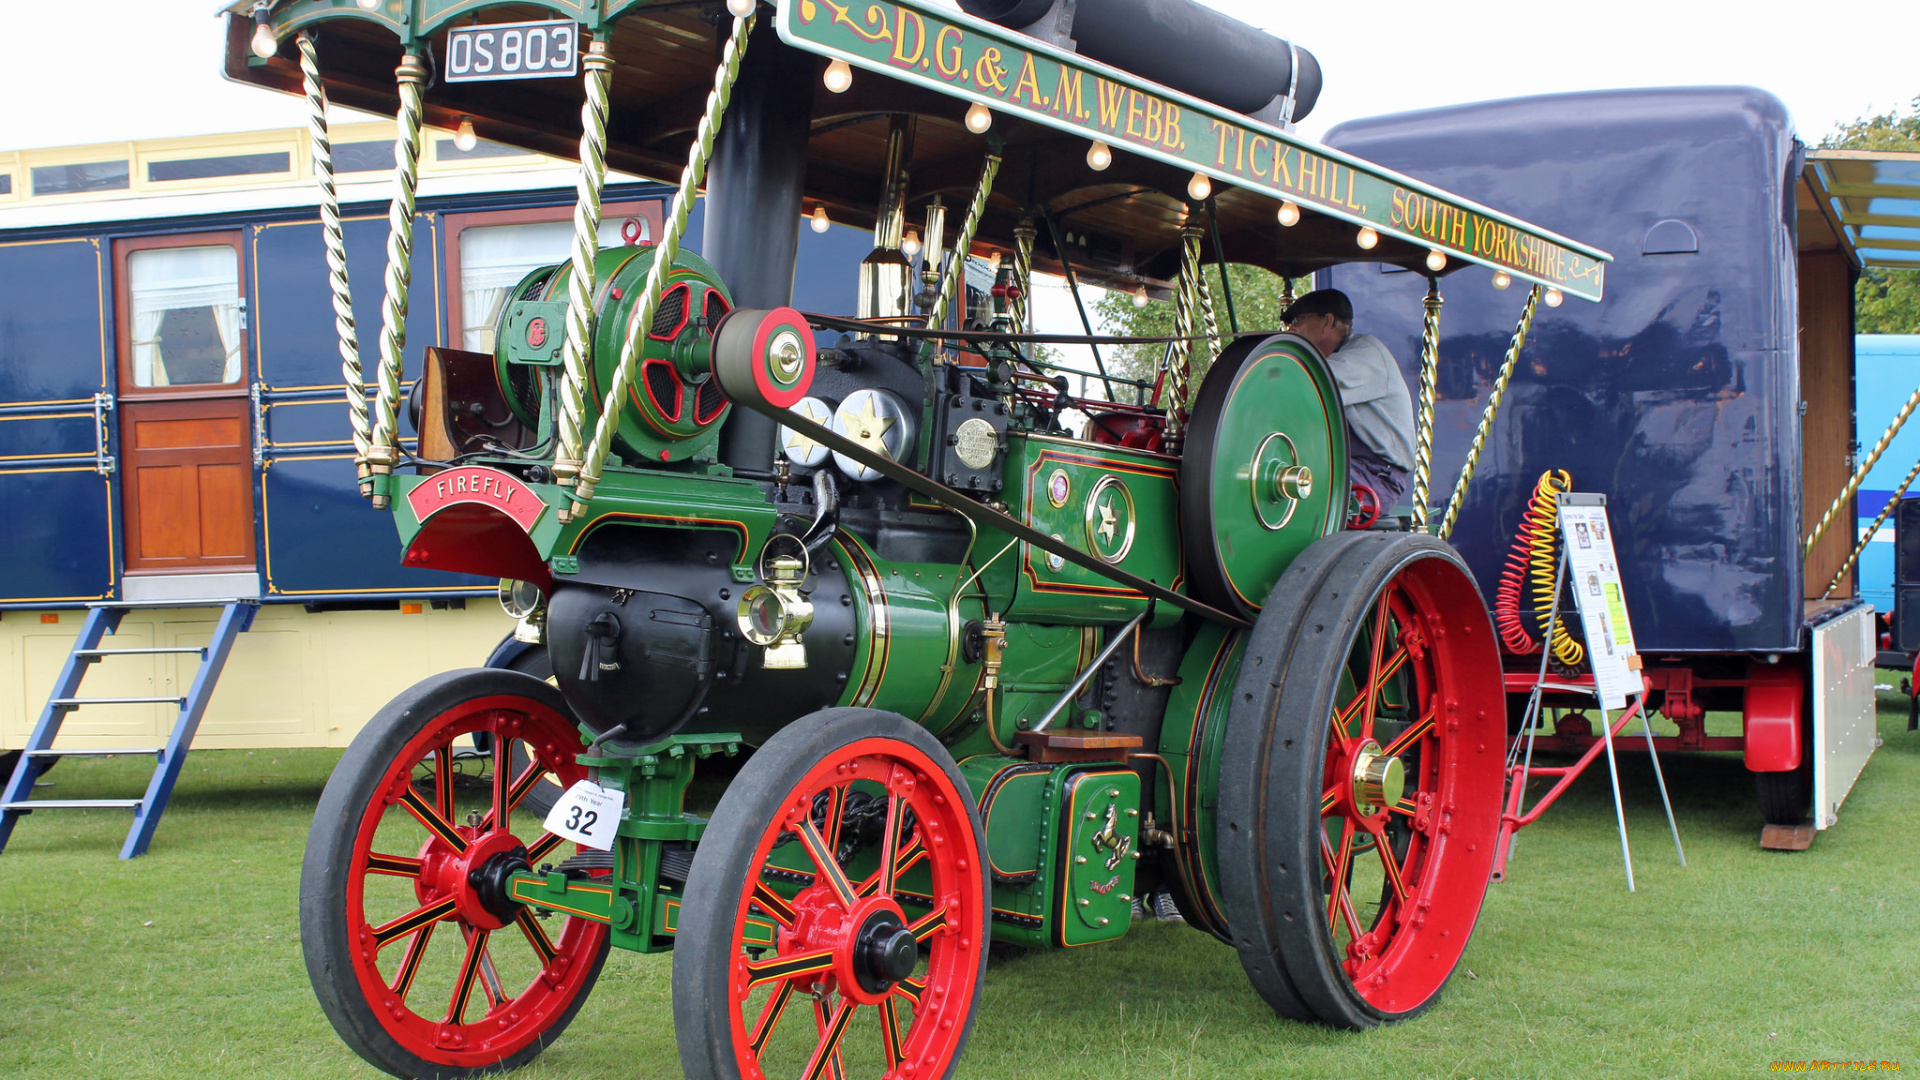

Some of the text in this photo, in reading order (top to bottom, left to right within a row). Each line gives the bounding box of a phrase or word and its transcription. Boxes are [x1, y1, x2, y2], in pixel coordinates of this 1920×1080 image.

[451, 26, 573, 74] OS 803
[973, 47, 1009, 96] &
[1095, 77, 1186, 154] WEBB.
[1209, 119, 1367, 216] TICKHILL,
[1389, 187, 1468, 250] SOUTH
[1471, 215, 1568, 285] YORKSHIRE.
[436, 475, 516, 503] FIREFLY
[565, 805, 598, 836] 32
